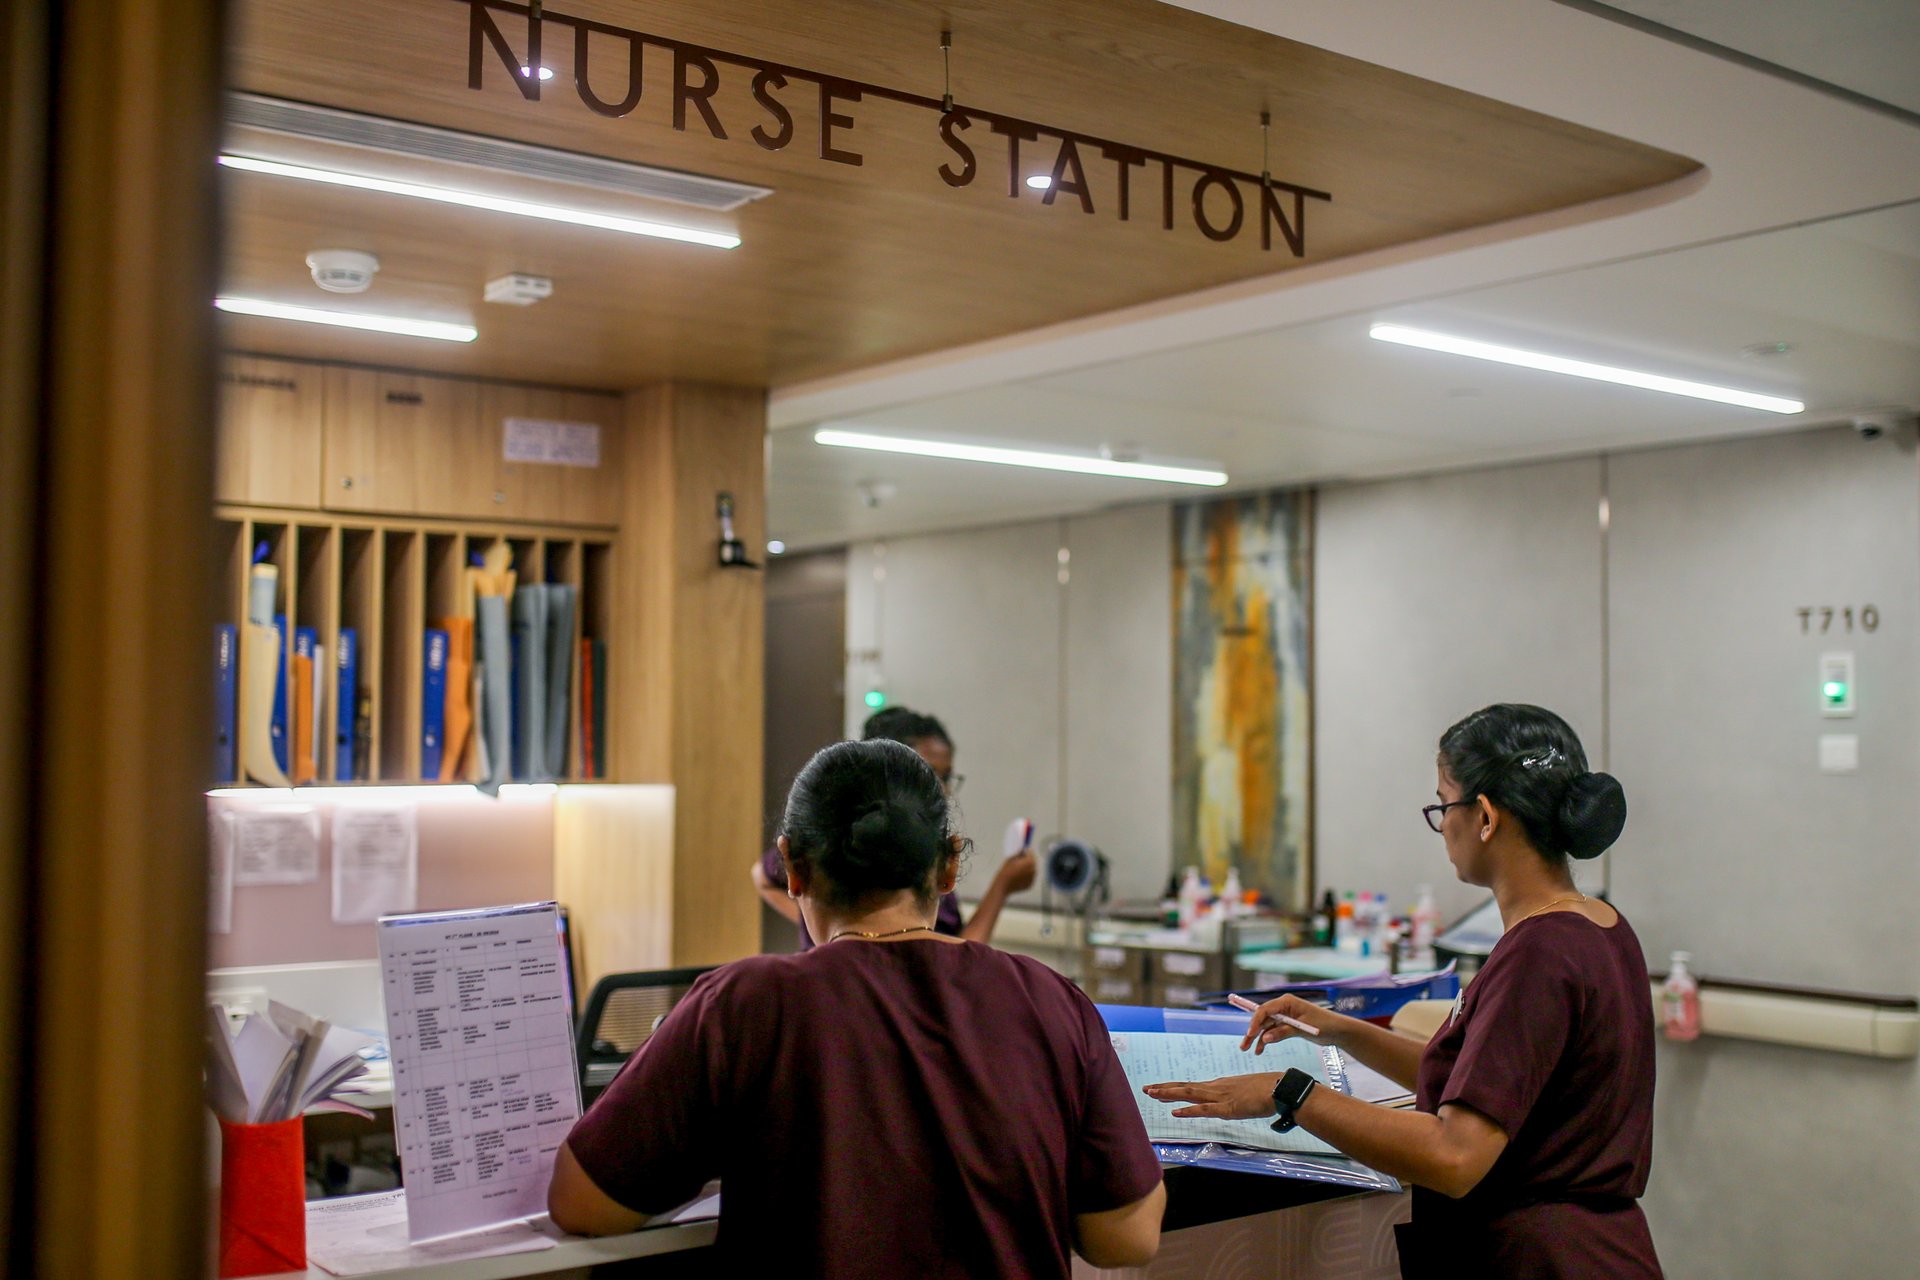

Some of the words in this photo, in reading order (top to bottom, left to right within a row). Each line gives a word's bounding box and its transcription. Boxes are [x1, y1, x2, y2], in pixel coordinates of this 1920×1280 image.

[468, 1, 864, 166] NURSE
[938, 110, 1305, 257] STATION
[1796, 604, 1880, 635] T710
